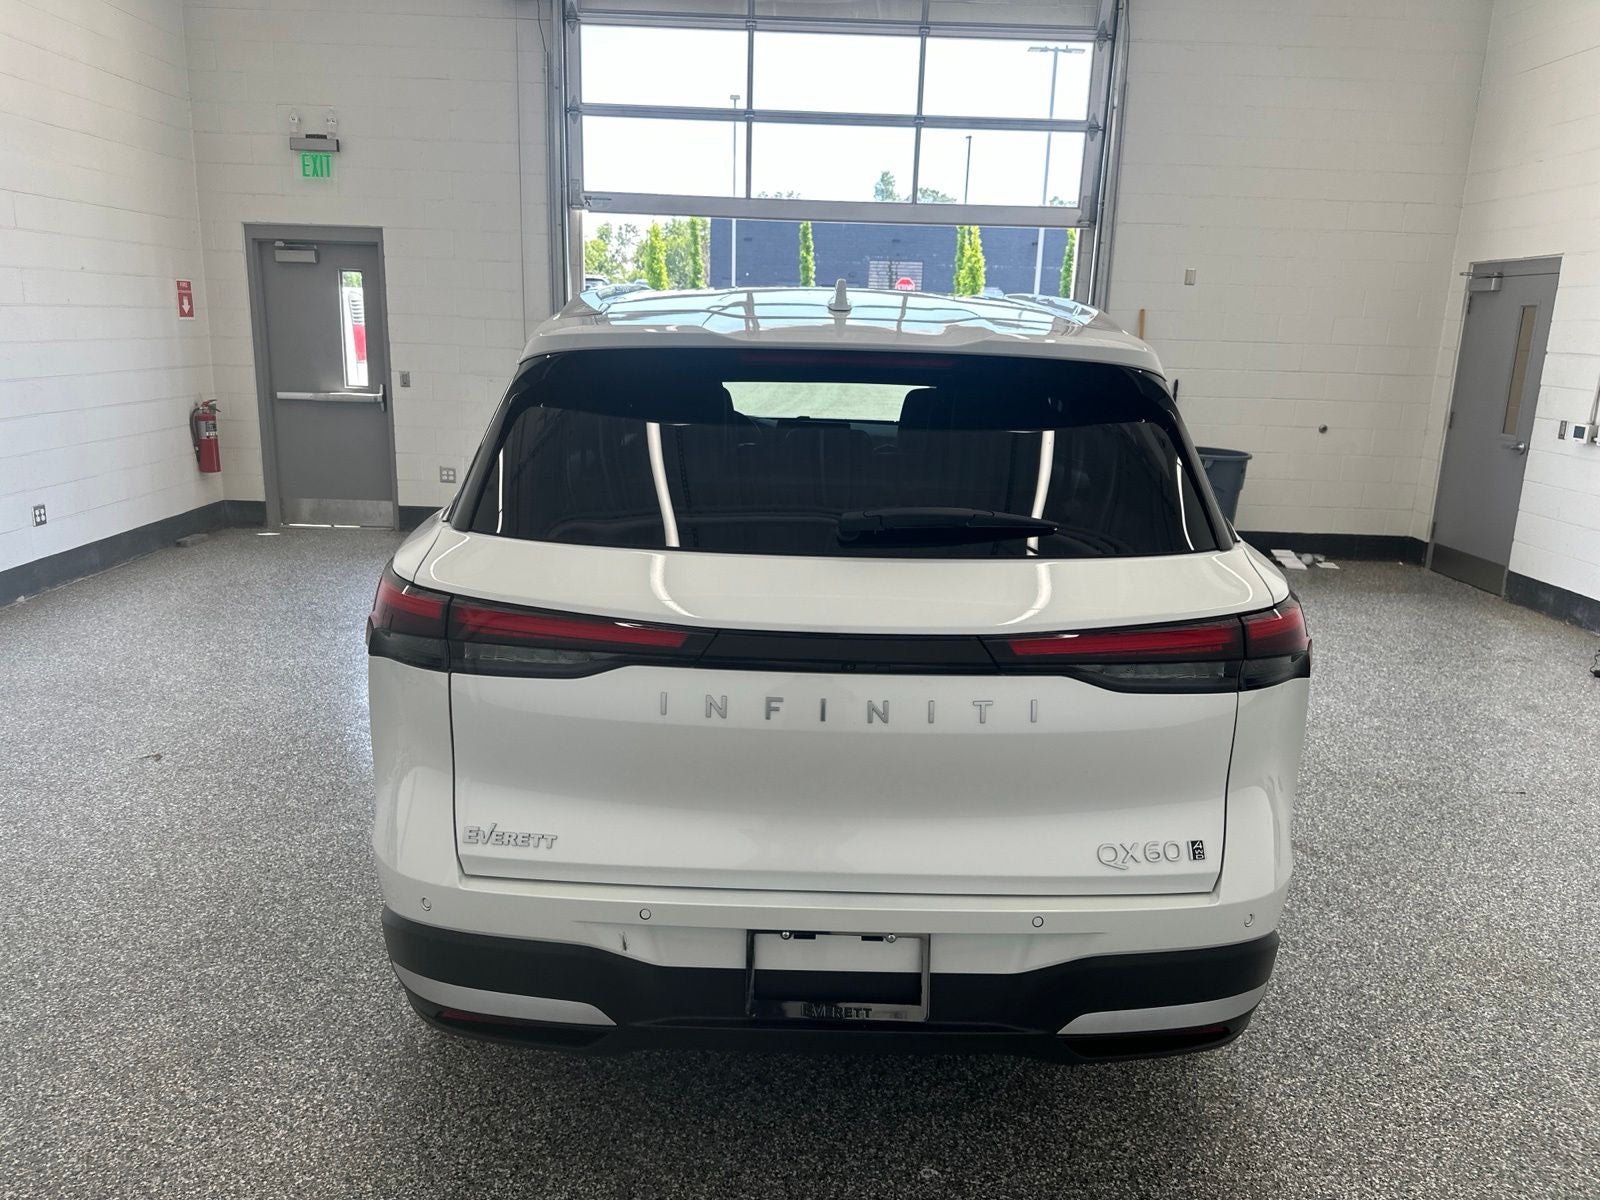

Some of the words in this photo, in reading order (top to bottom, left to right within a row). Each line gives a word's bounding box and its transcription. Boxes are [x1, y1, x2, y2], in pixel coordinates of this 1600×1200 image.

[301, 153, 332, 178] EXIT
[660, 691, 1038, 724] INFINITI
[463, 823, 558, 849] EVERETT
[1097, 841, 1181, 870] QX60
[1193, 840, 1204, 860] AWD
[800, 1002, 873, 1019] EVERETT
